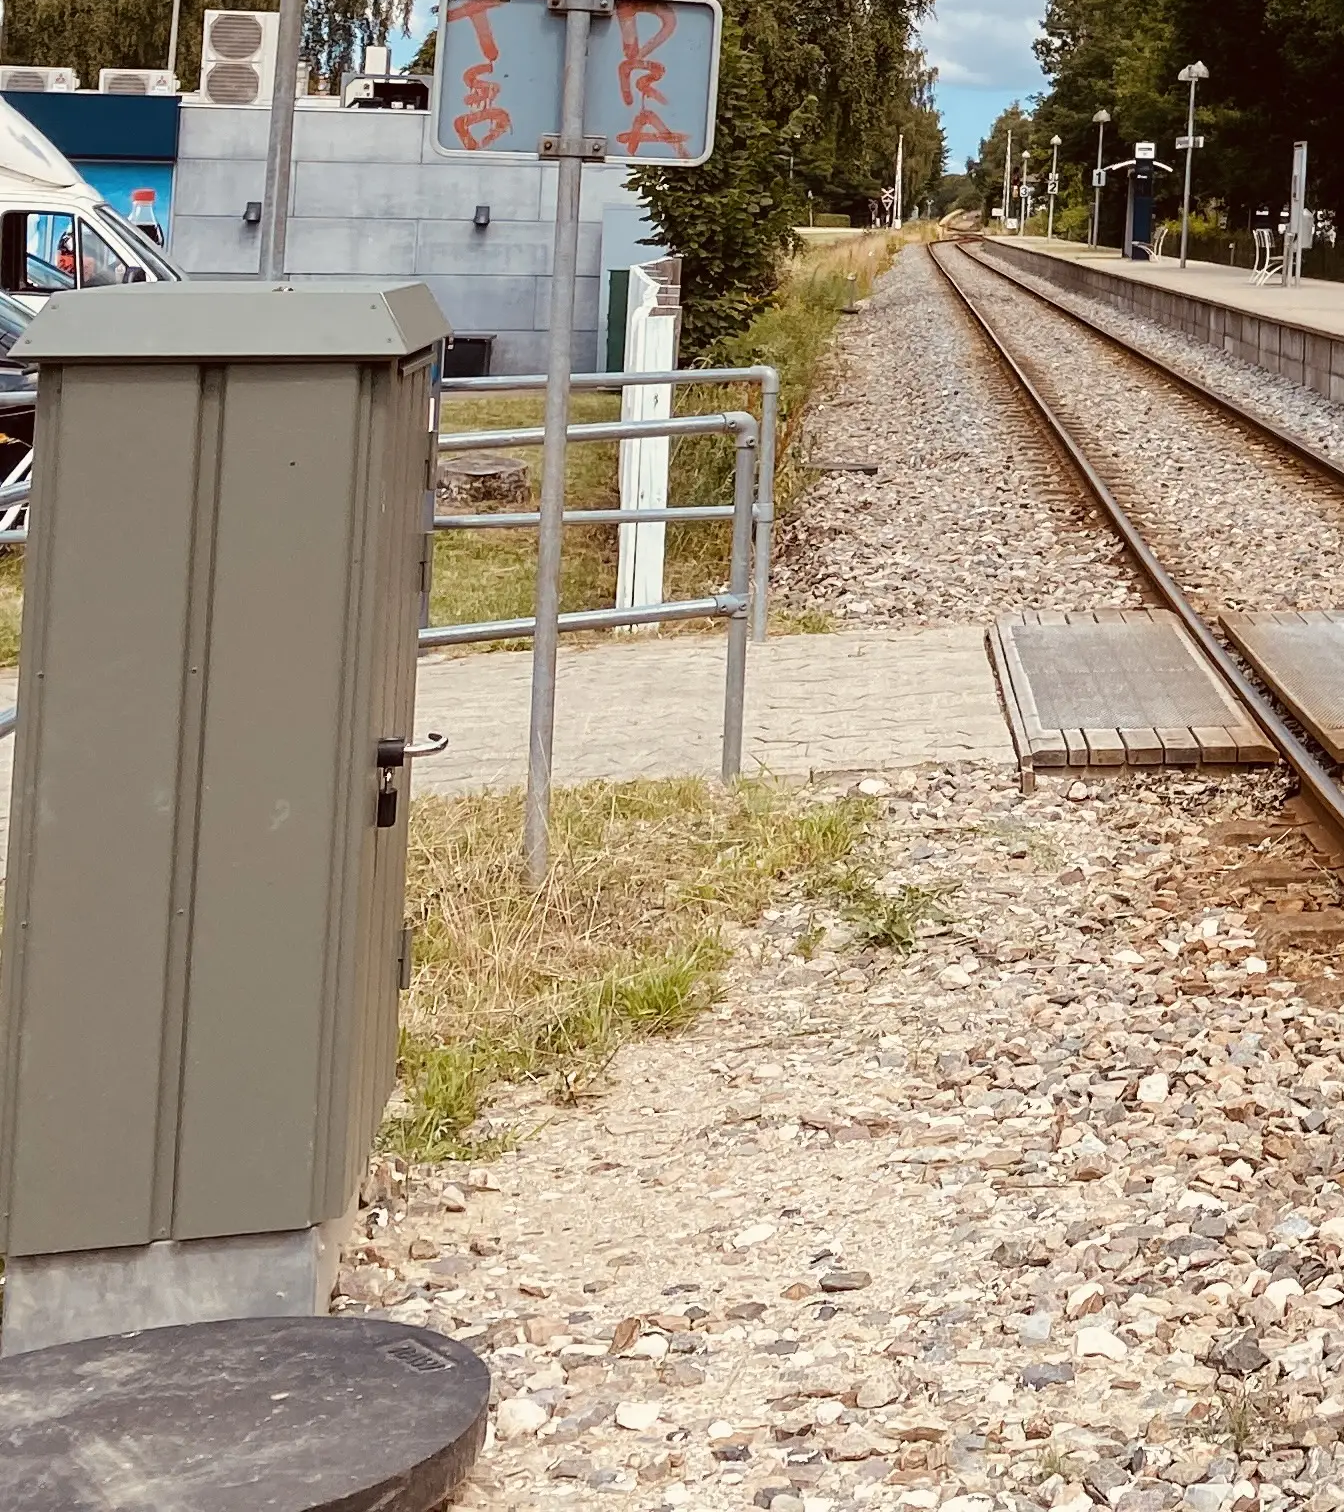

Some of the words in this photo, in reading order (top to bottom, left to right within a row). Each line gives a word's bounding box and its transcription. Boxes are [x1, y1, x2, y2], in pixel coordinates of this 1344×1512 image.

[1096, 172, 1101, 184] 1
[1021, 187, 1027, 195] 3
[1049, 182, 1056, 192] 2
